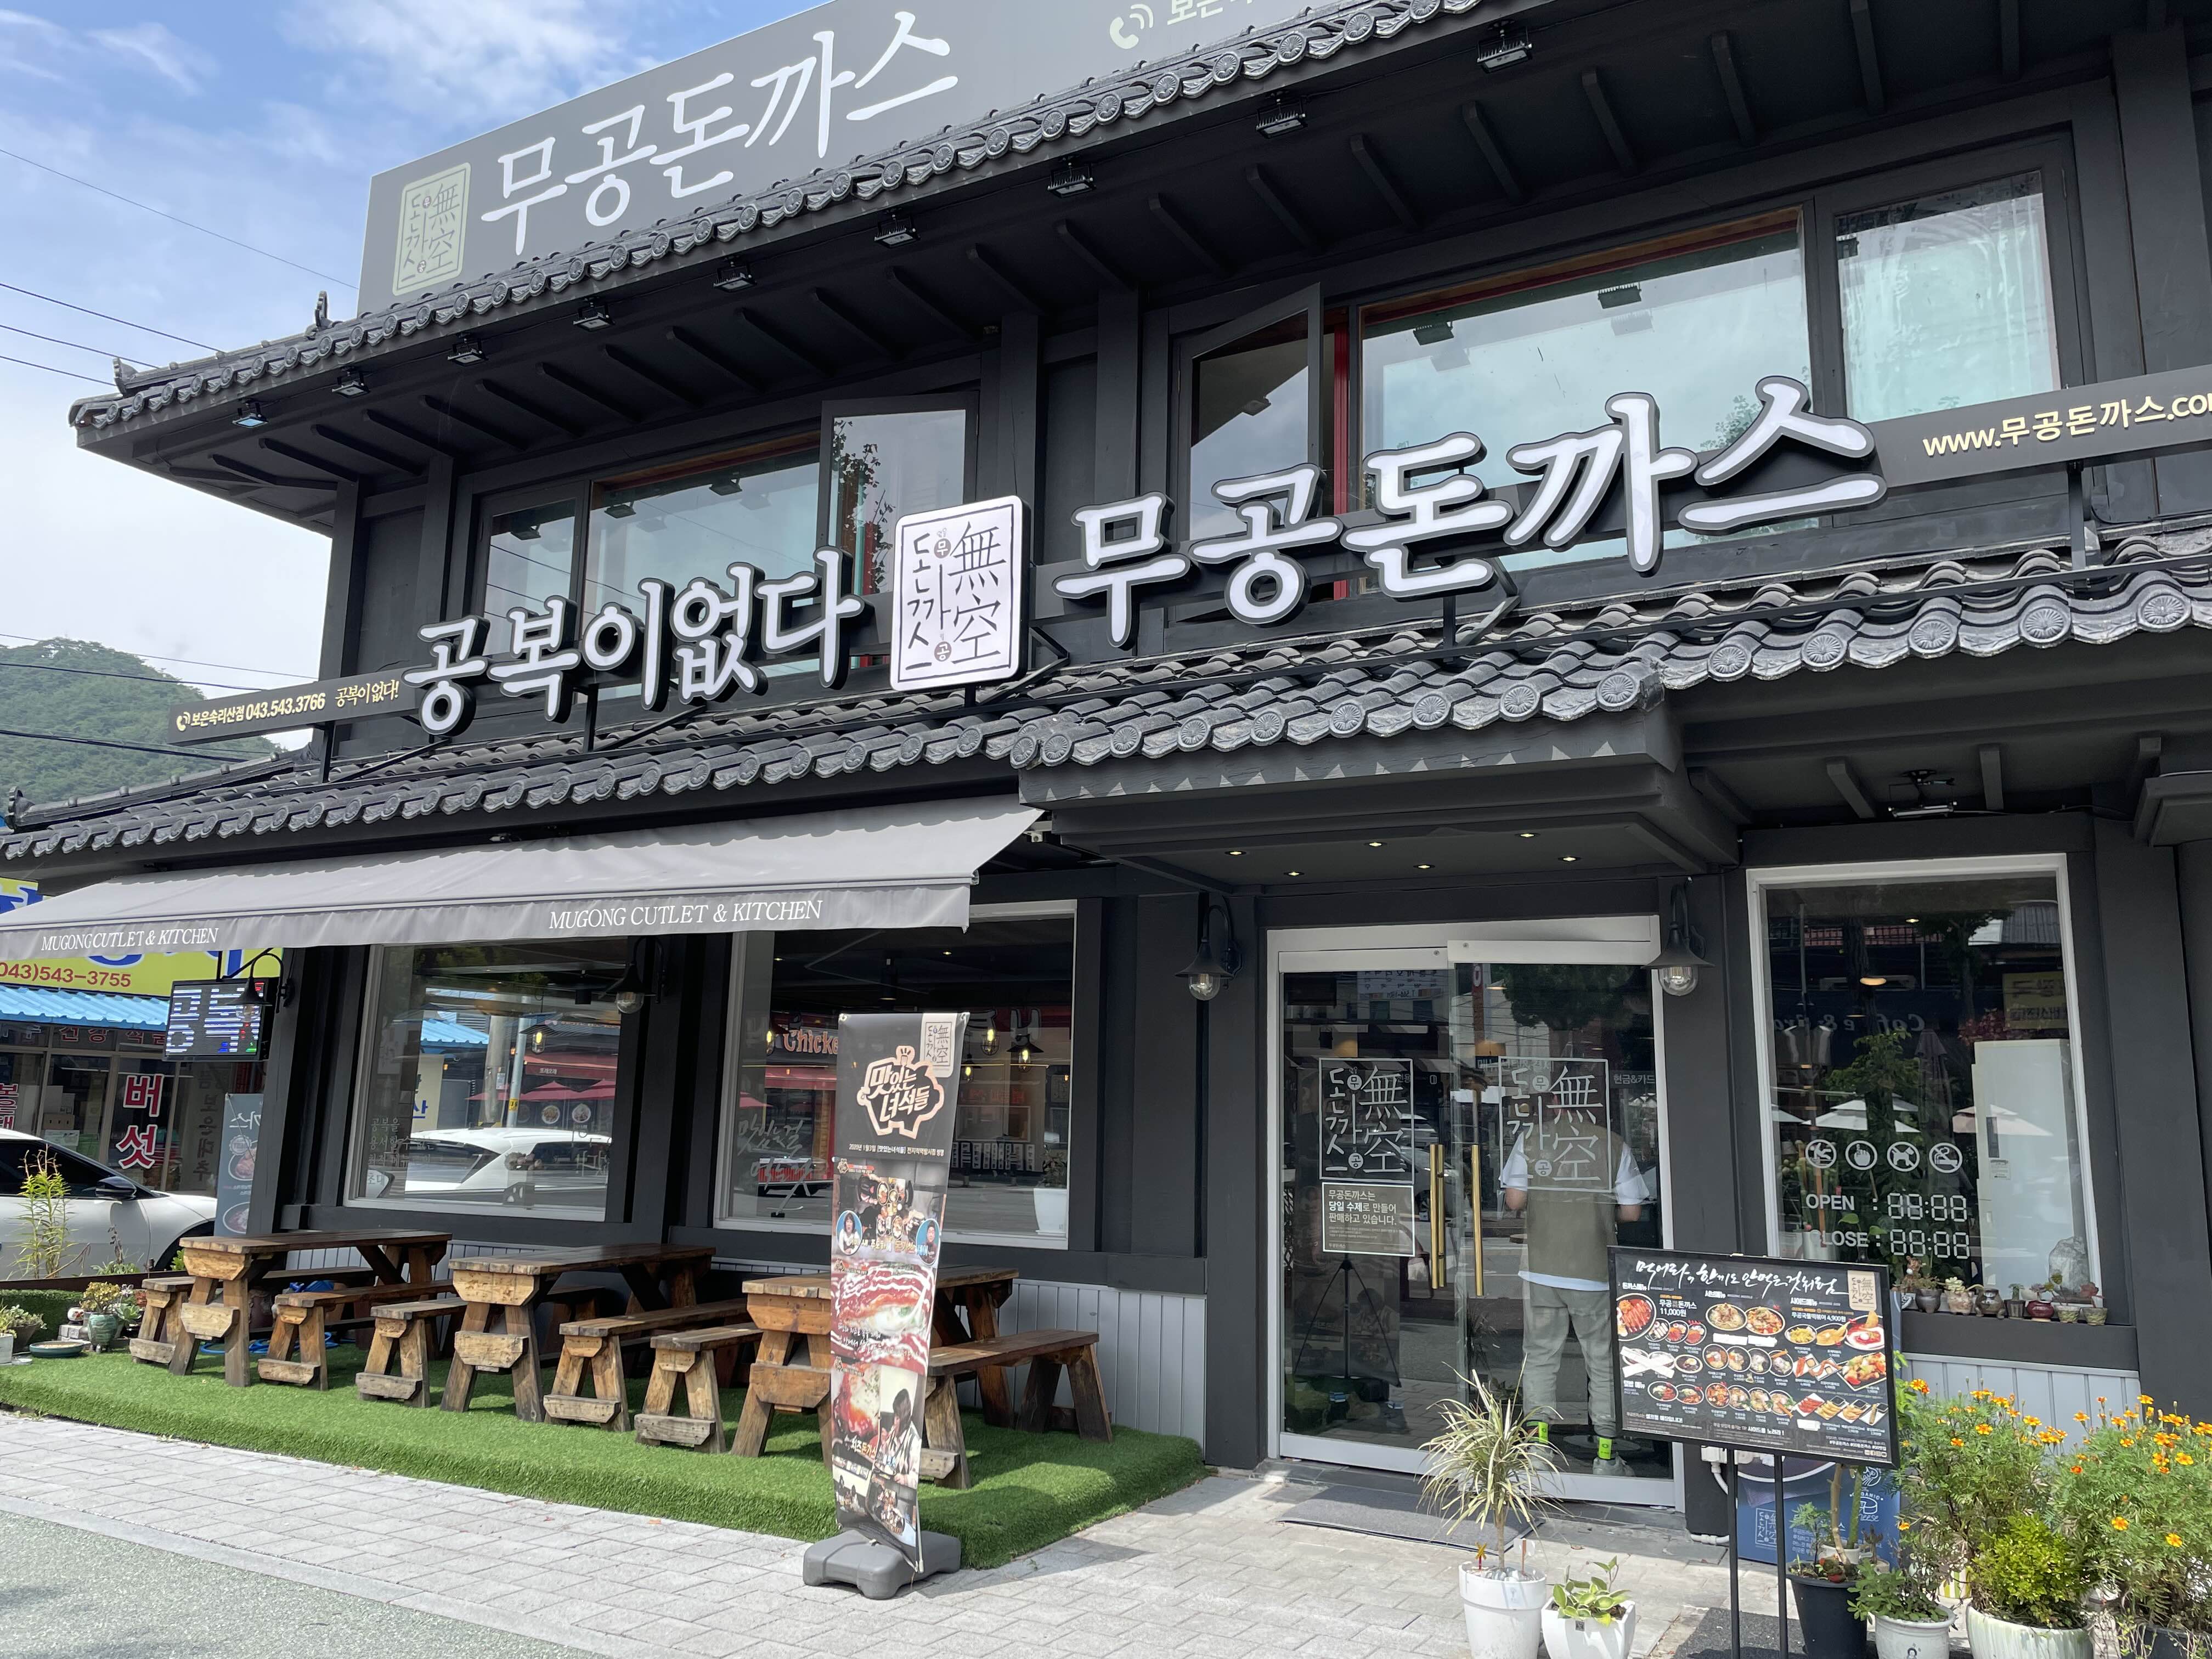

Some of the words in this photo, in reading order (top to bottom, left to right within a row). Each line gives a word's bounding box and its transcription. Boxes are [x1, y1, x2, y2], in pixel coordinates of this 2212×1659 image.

[481, 10, 960, 255] 무공돈까스
[1054, 376, 1888, 648] 무공돈까스
[947, 521, 1007, 664] 無空
[403, 548, 864, 736] 공복이없다
[191, 706, 245, 727] 보은속리산점
[246, 693, 326, 719] 043.543.3766
[549, 908, 627, 929] MUGONG
[630, 905, 709, 925] CUTLET
[713, 904, 727, 922] &
[732, 900, 823, 922] KITCHEN
[41, 934, 92, 951] MUGONG
[92, 931, 144, 949] CUTLET
[145, 932, 155, 946] &
[157, 928, 219, 945] KITCHEN
[867, 1064, 917, 1099] 맛있는
[116, 1074, 164, 1169] 버섯
[879, 1086, 930, 1122] 녀석들
[1358, 1065, 1408, 1173] 無空
[1546, 1065, 1604, 1181] 無空
[1328, 1189, 1376, 1201] 무공돈까스는
[1329, 1201, 1344, 1212] 당일
[1346, 1202, 1370, 1212] 수제로
[1373, 1203, 1396, 1214] 만들어
[1805, 1194, 1855, 1211] OPEN
[1329, 1212, 1361, 1223] 판매하고
[1362, 1215, 1397, 1226] 있습니다.
[1660, 1308, 1687, 1317] 11,000원
